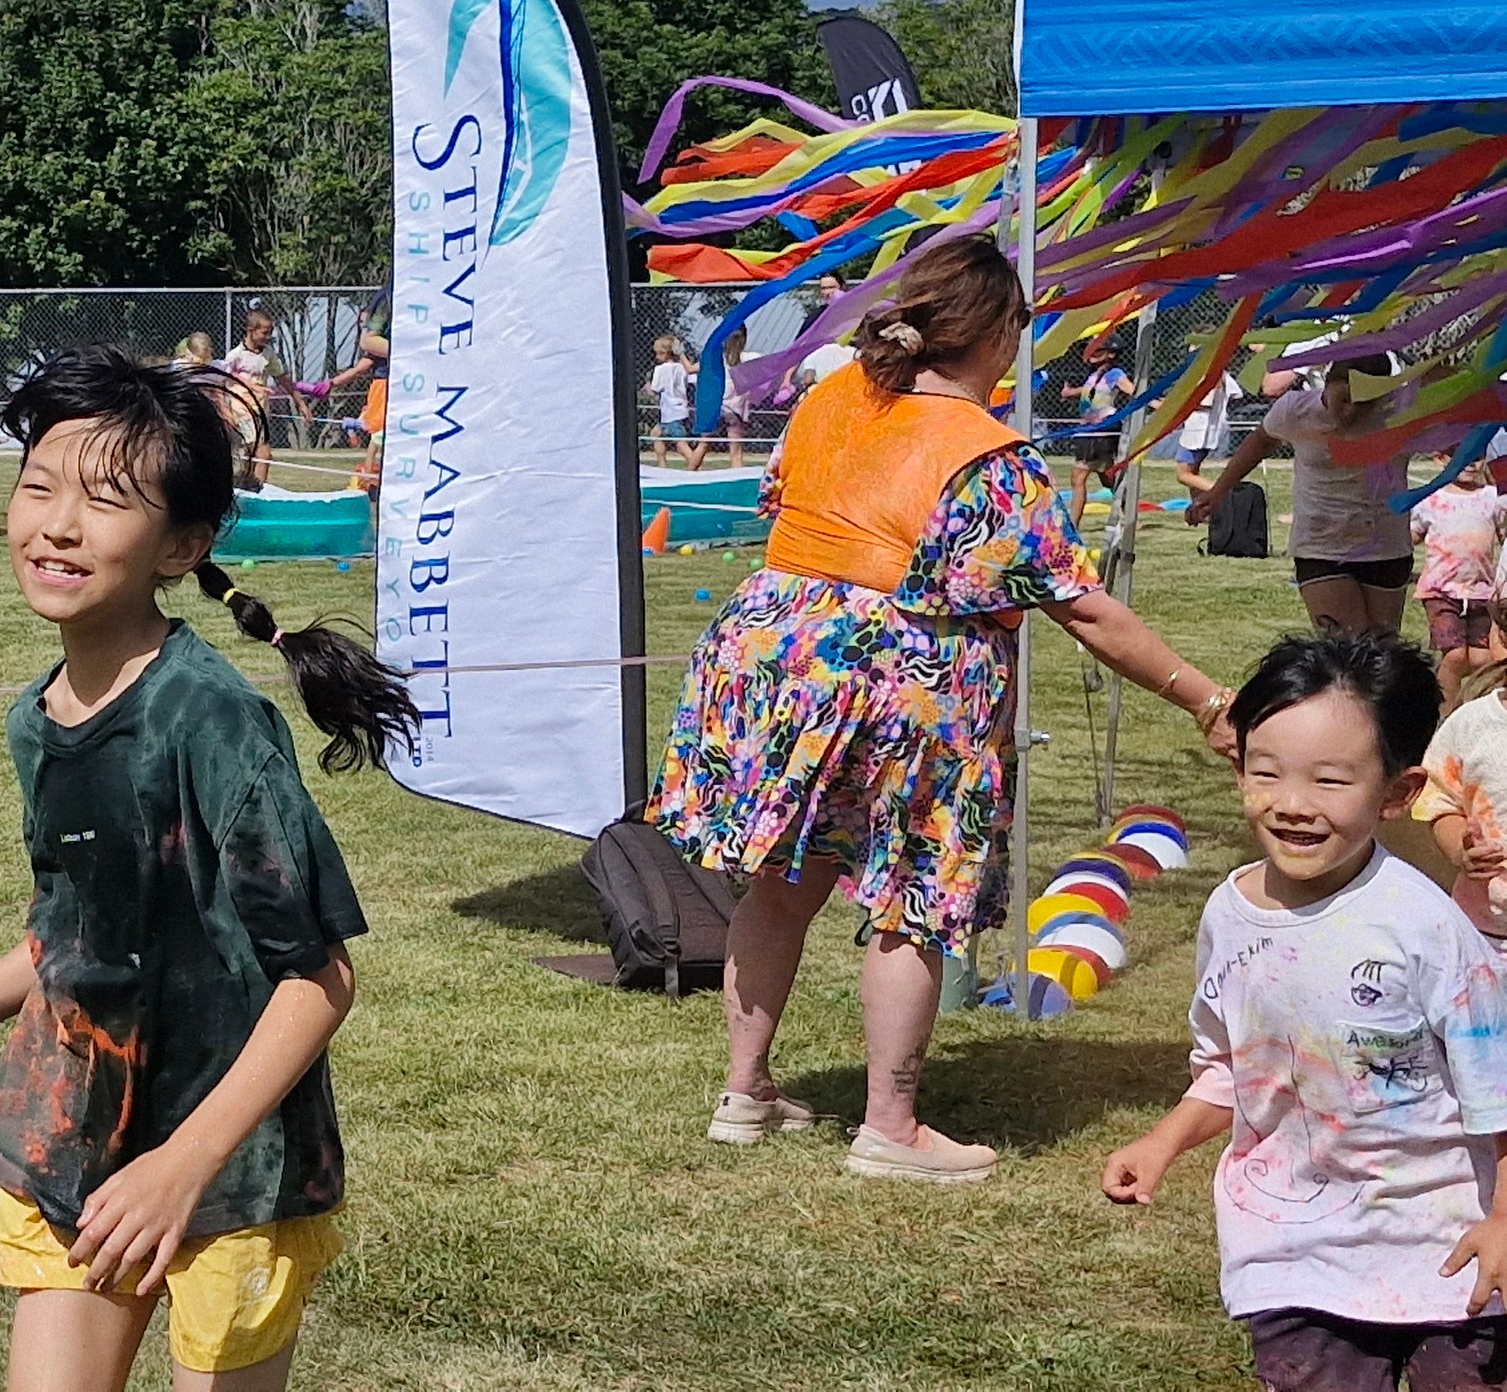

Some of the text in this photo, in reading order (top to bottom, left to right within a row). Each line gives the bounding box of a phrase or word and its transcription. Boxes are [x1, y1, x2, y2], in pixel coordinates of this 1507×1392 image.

[384, 191, 432, 684] SHIP SURVEYO
[408, 114, 482, 739] STEVE MABBETT
